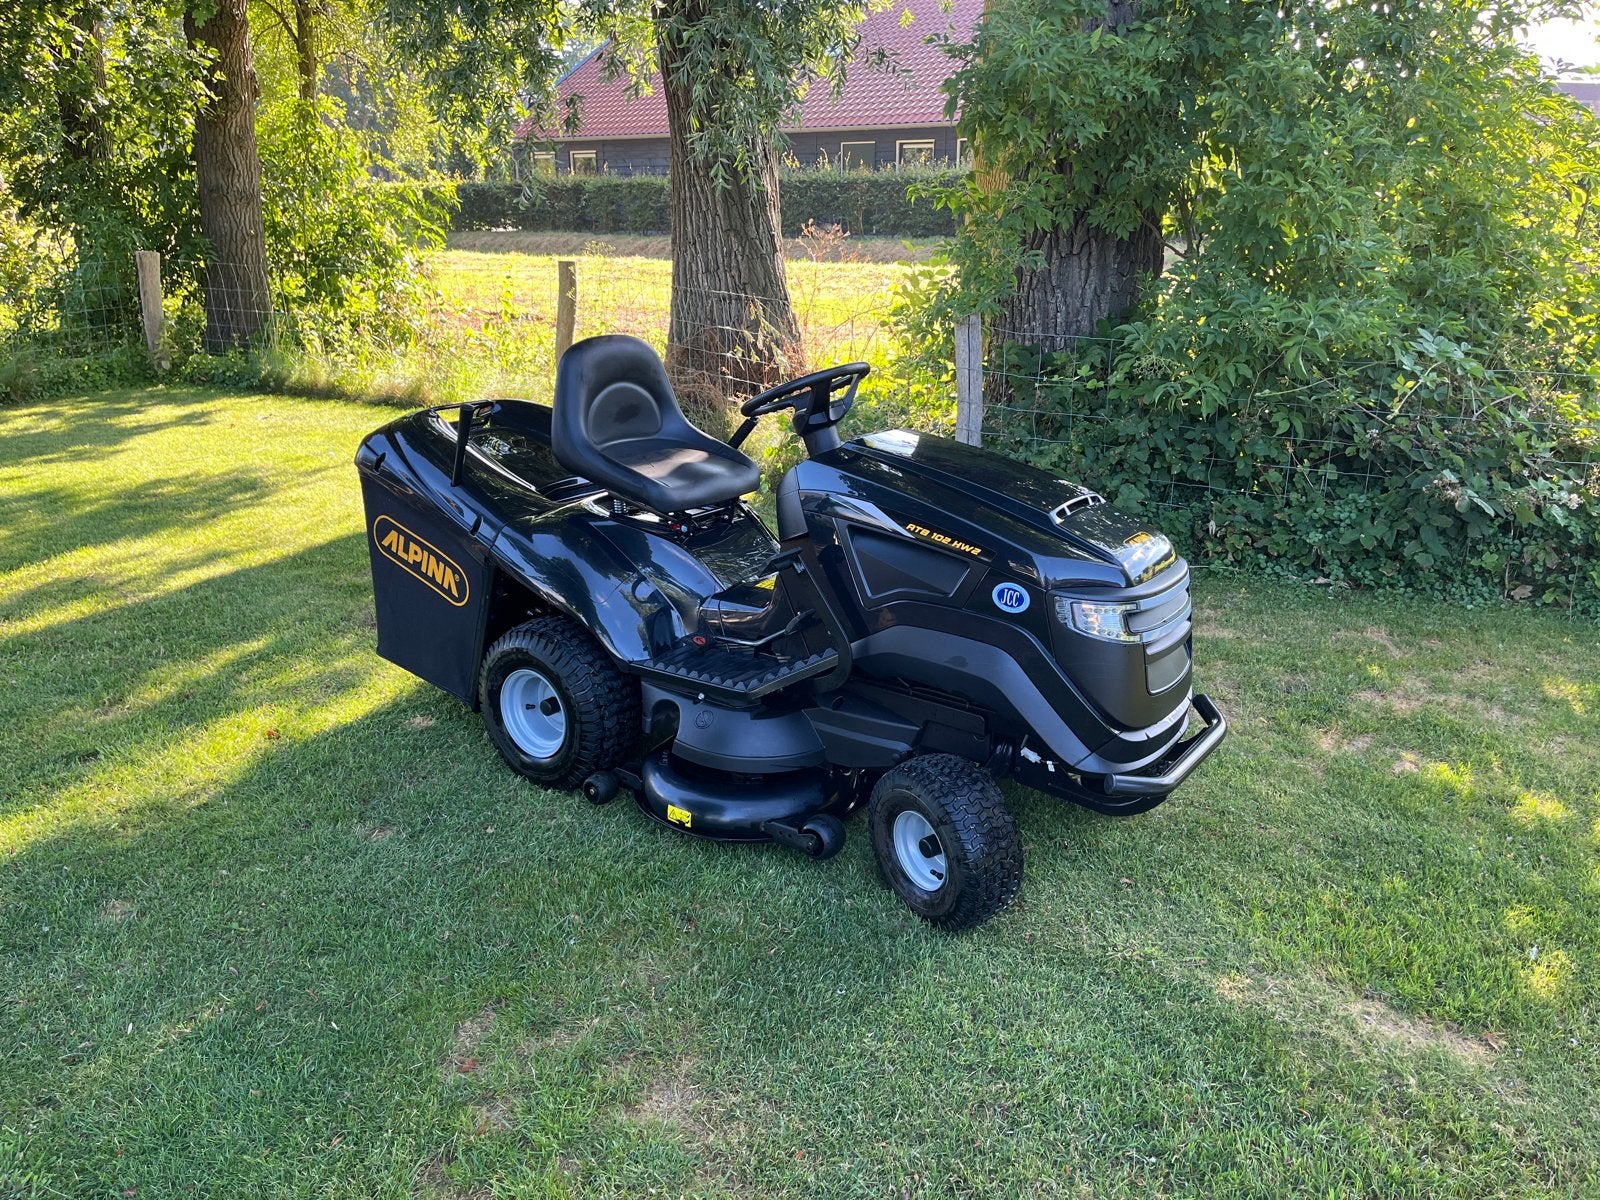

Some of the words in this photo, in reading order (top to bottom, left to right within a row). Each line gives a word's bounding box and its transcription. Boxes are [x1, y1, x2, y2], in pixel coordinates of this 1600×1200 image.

[931, 532, 952, 545] 102
[952, 540, 982, 556] HW2
[381, 529, 459, 598] ALPINA
[1000, 588, 1020, 607] JCC
